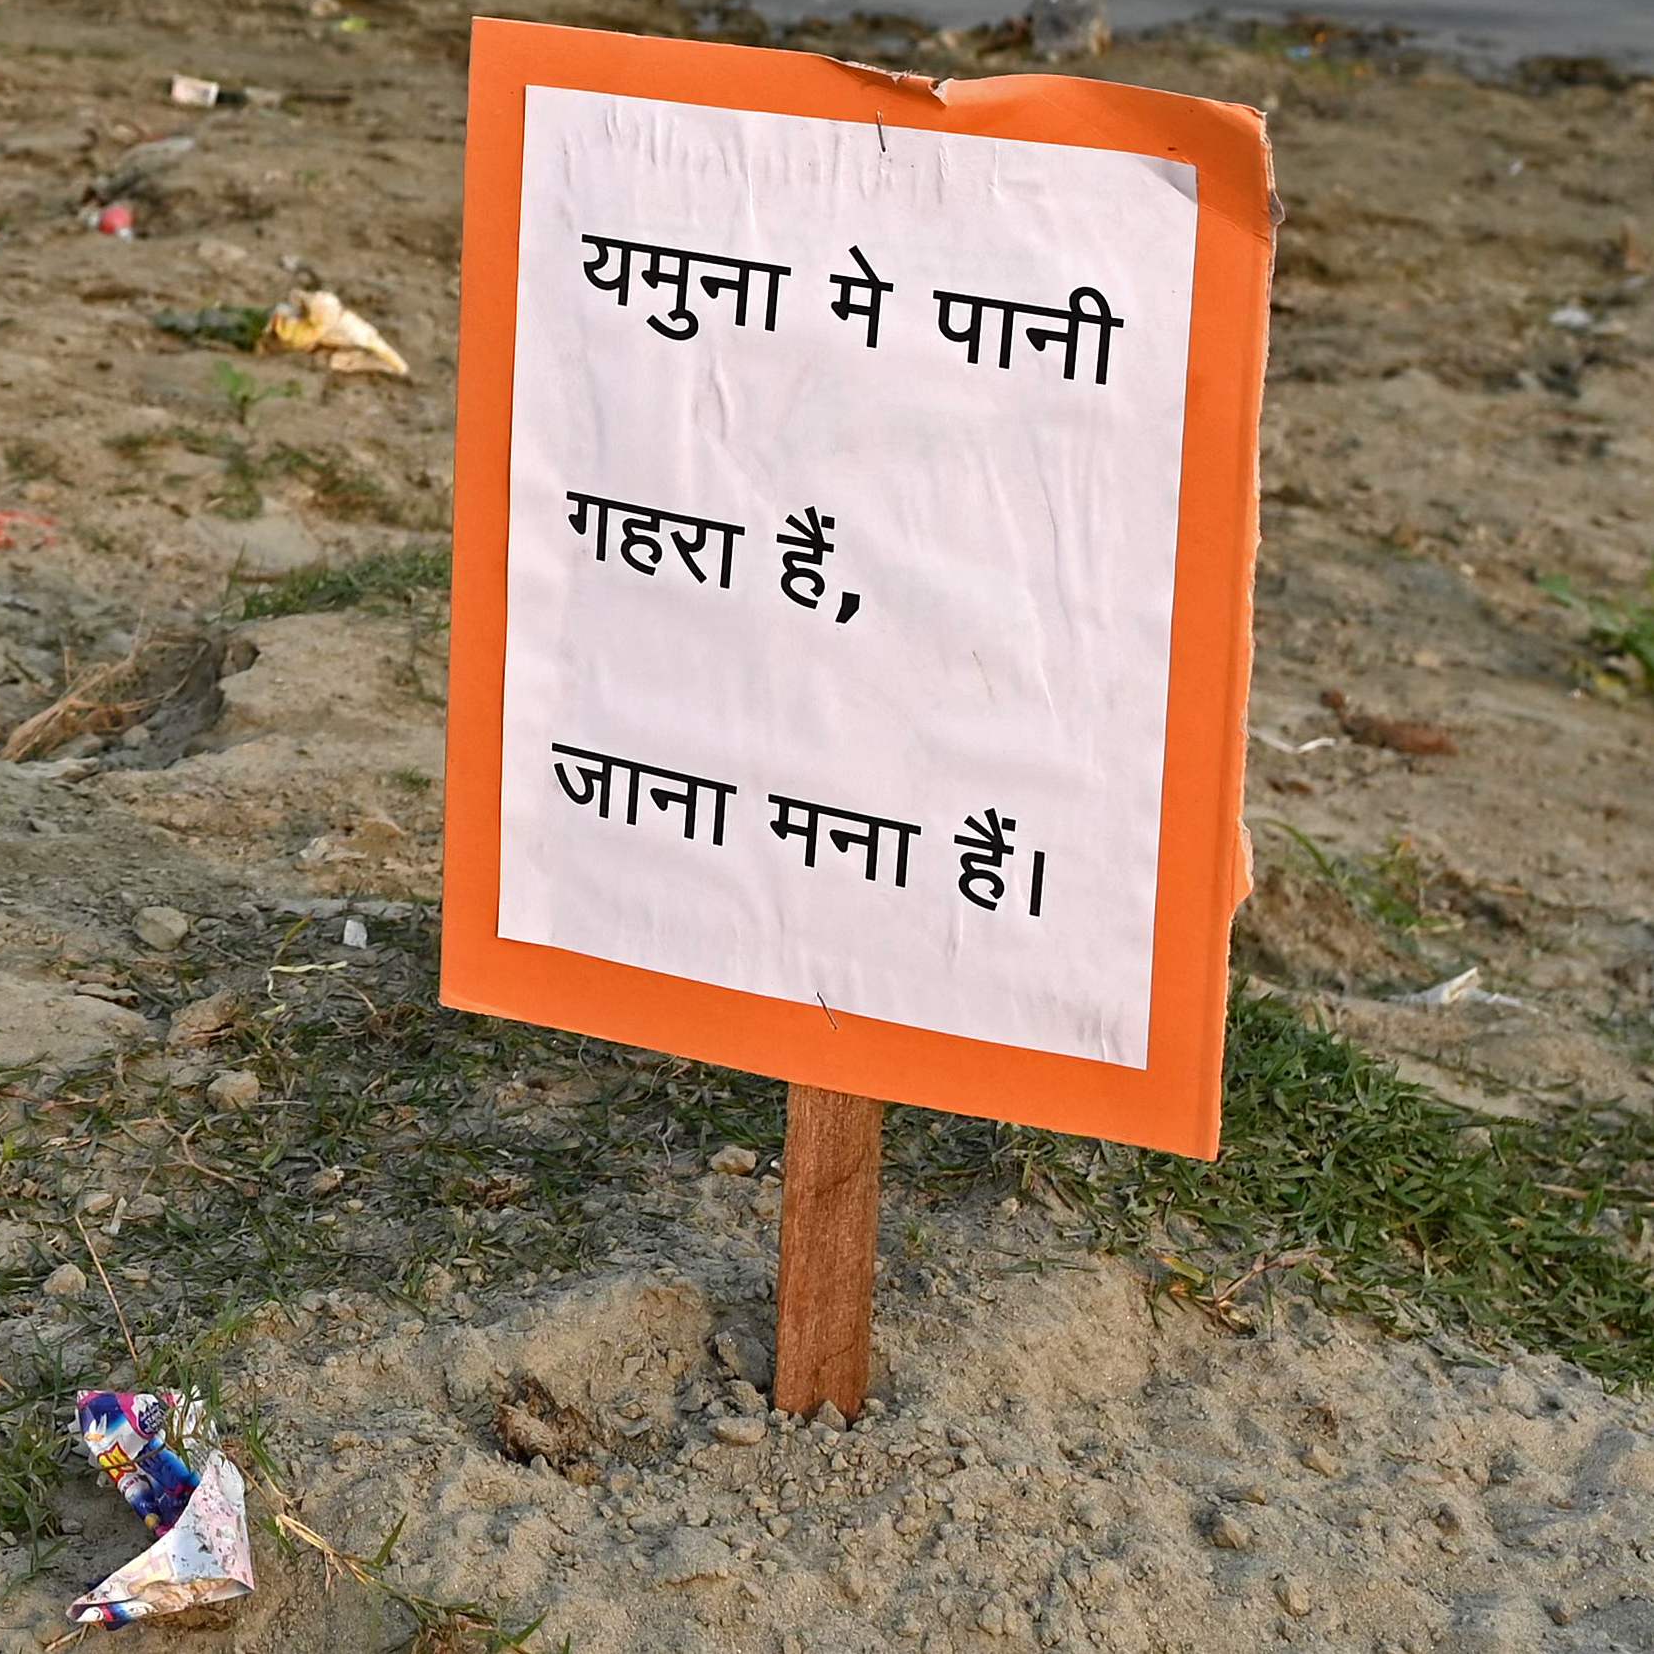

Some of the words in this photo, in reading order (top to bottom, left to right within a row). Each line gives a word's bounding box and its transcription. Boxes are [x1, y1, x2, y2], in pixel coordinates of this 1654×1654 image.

[581, 233, 792, 341] यमुना
[829, 245, 894, 349] मे
[932, 286, 1125, 386] पानी
[566, 490, 746, 589] गहरा
[776, 505, 861, 624] हैं,
[552, 743, 738, 847] जाना
[768, 793, 922, 888] मना
[953, 807, 1046, 917] हैं।
